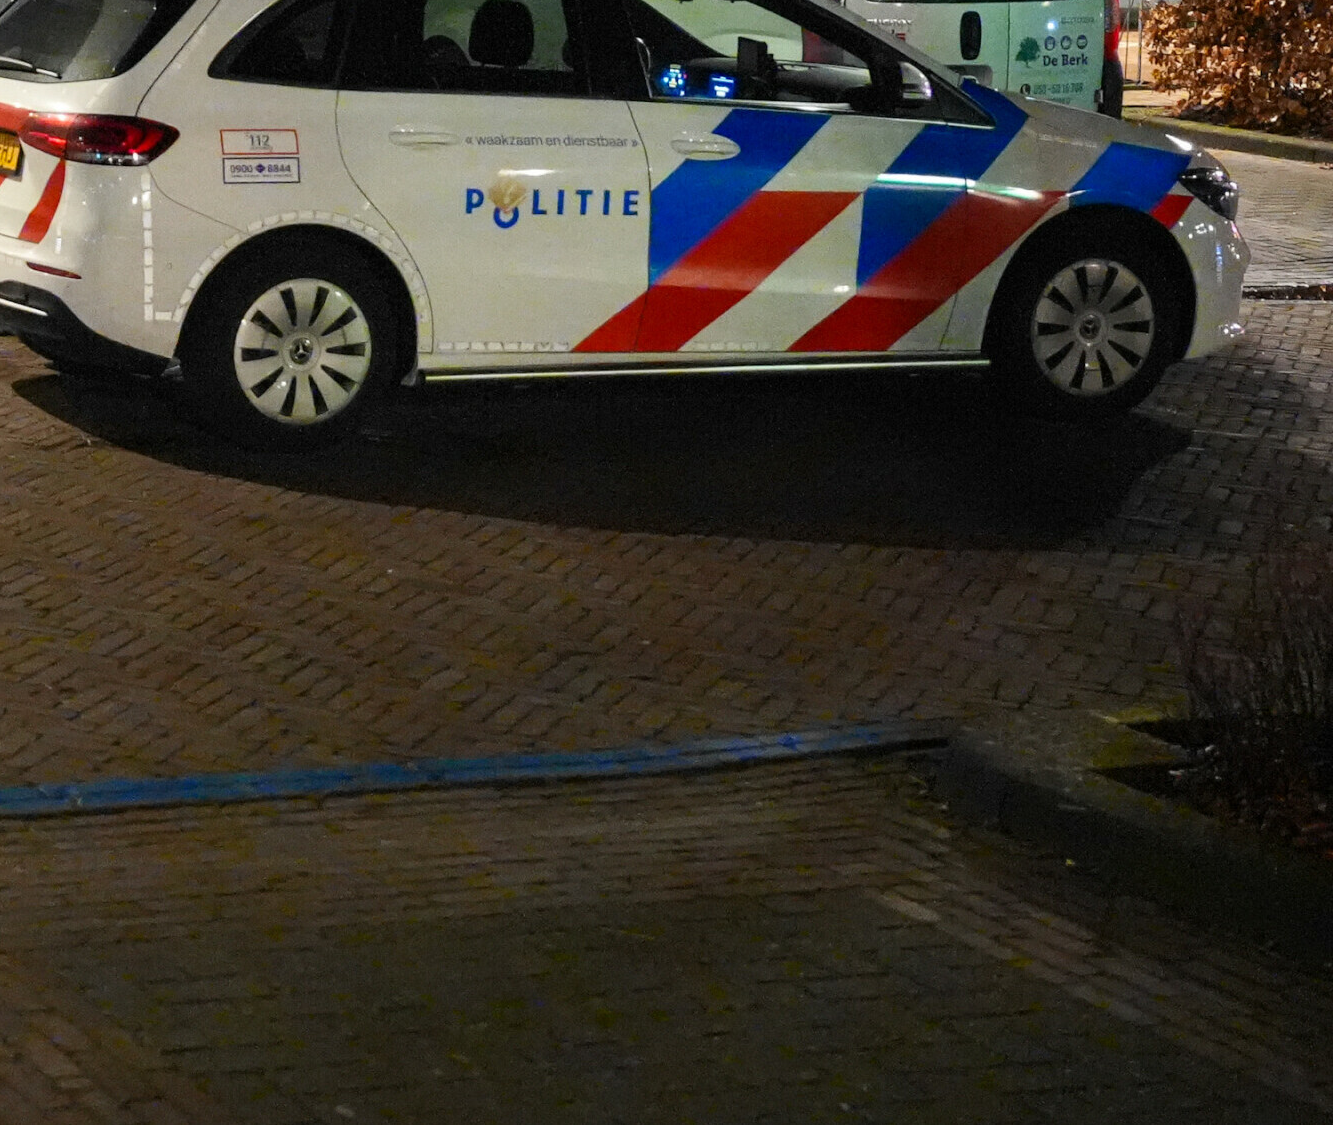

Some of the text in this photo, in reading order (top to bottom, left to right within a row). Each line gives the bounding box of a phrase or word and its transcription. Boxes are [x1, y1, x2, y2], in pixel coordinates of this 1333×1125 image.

[1043, 54, 1088, 66] De Berk
[250, 135, 270, 147] 112
[477, 135, 543, 145] waakzaam
[546, 138, 562, 146] en
[563, 135, 628, 147] dienstbaar
[465, 188, 639, 228] POLITIE
